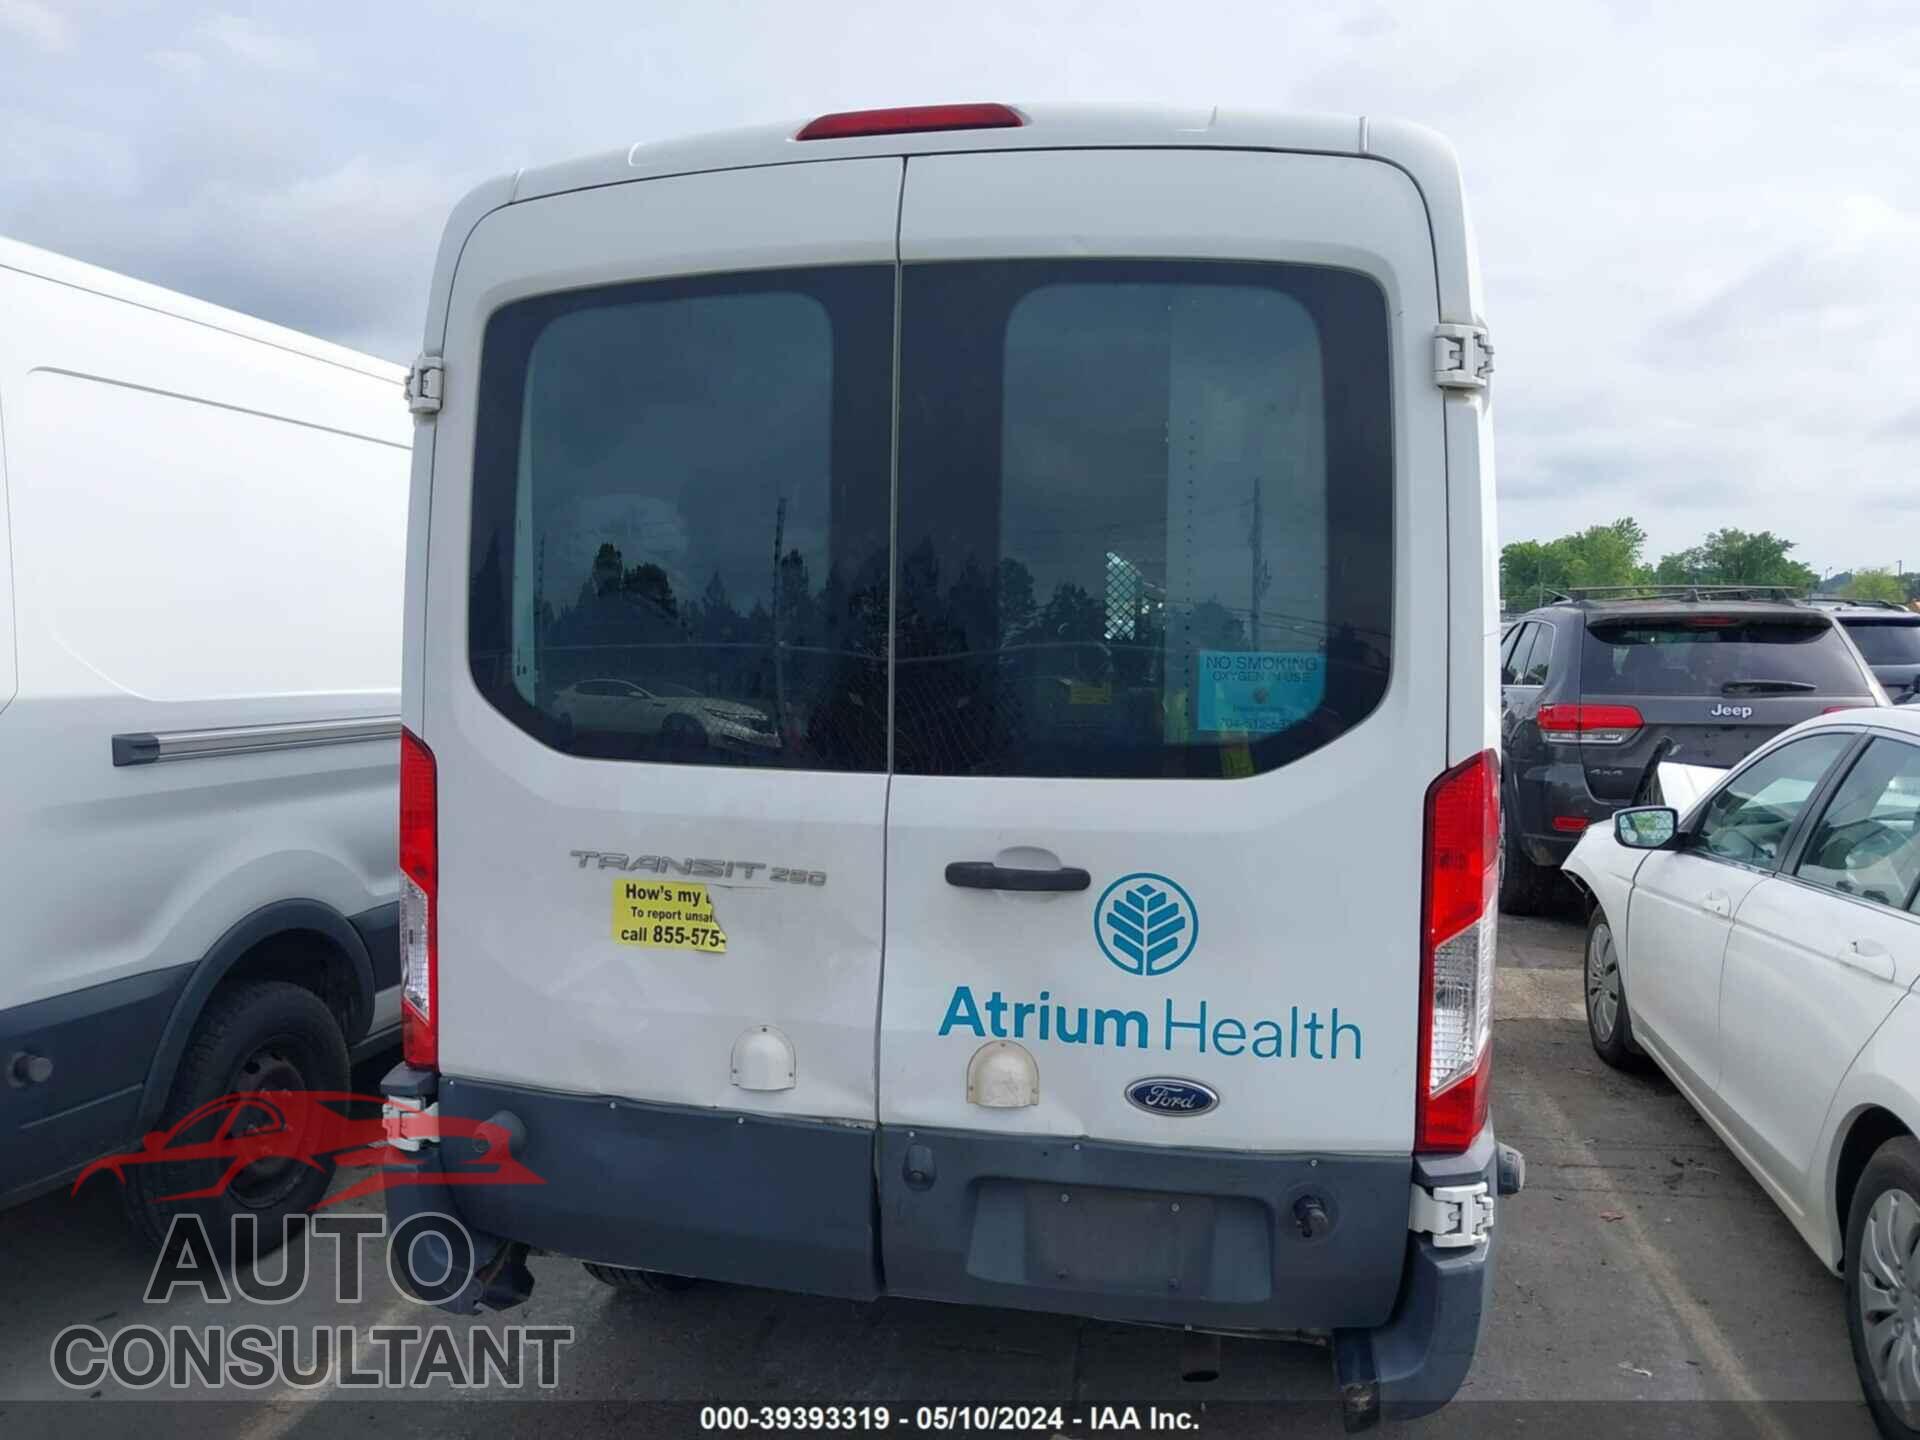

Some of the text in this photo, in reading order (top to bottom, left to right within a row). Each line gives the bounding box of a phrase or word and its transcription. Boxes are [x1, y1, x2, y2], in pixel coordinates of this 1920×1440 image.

[1206, 655, 1317, 670] NO SMOKING
[1711, 704, 1752, 718] Jeep
[569, 850, 827, 887] TRANSIT 250
[625, 883, 672, 901] How's
[678, 890, 701, 907] my
[630, 906, 644, 918] To
[647, 909, 682, 921] report
[621, 926, 647, 942] call
[938, 985, 1363, 1060] Atrium Health
[1145, 1085, 1197, 1109] Ford
